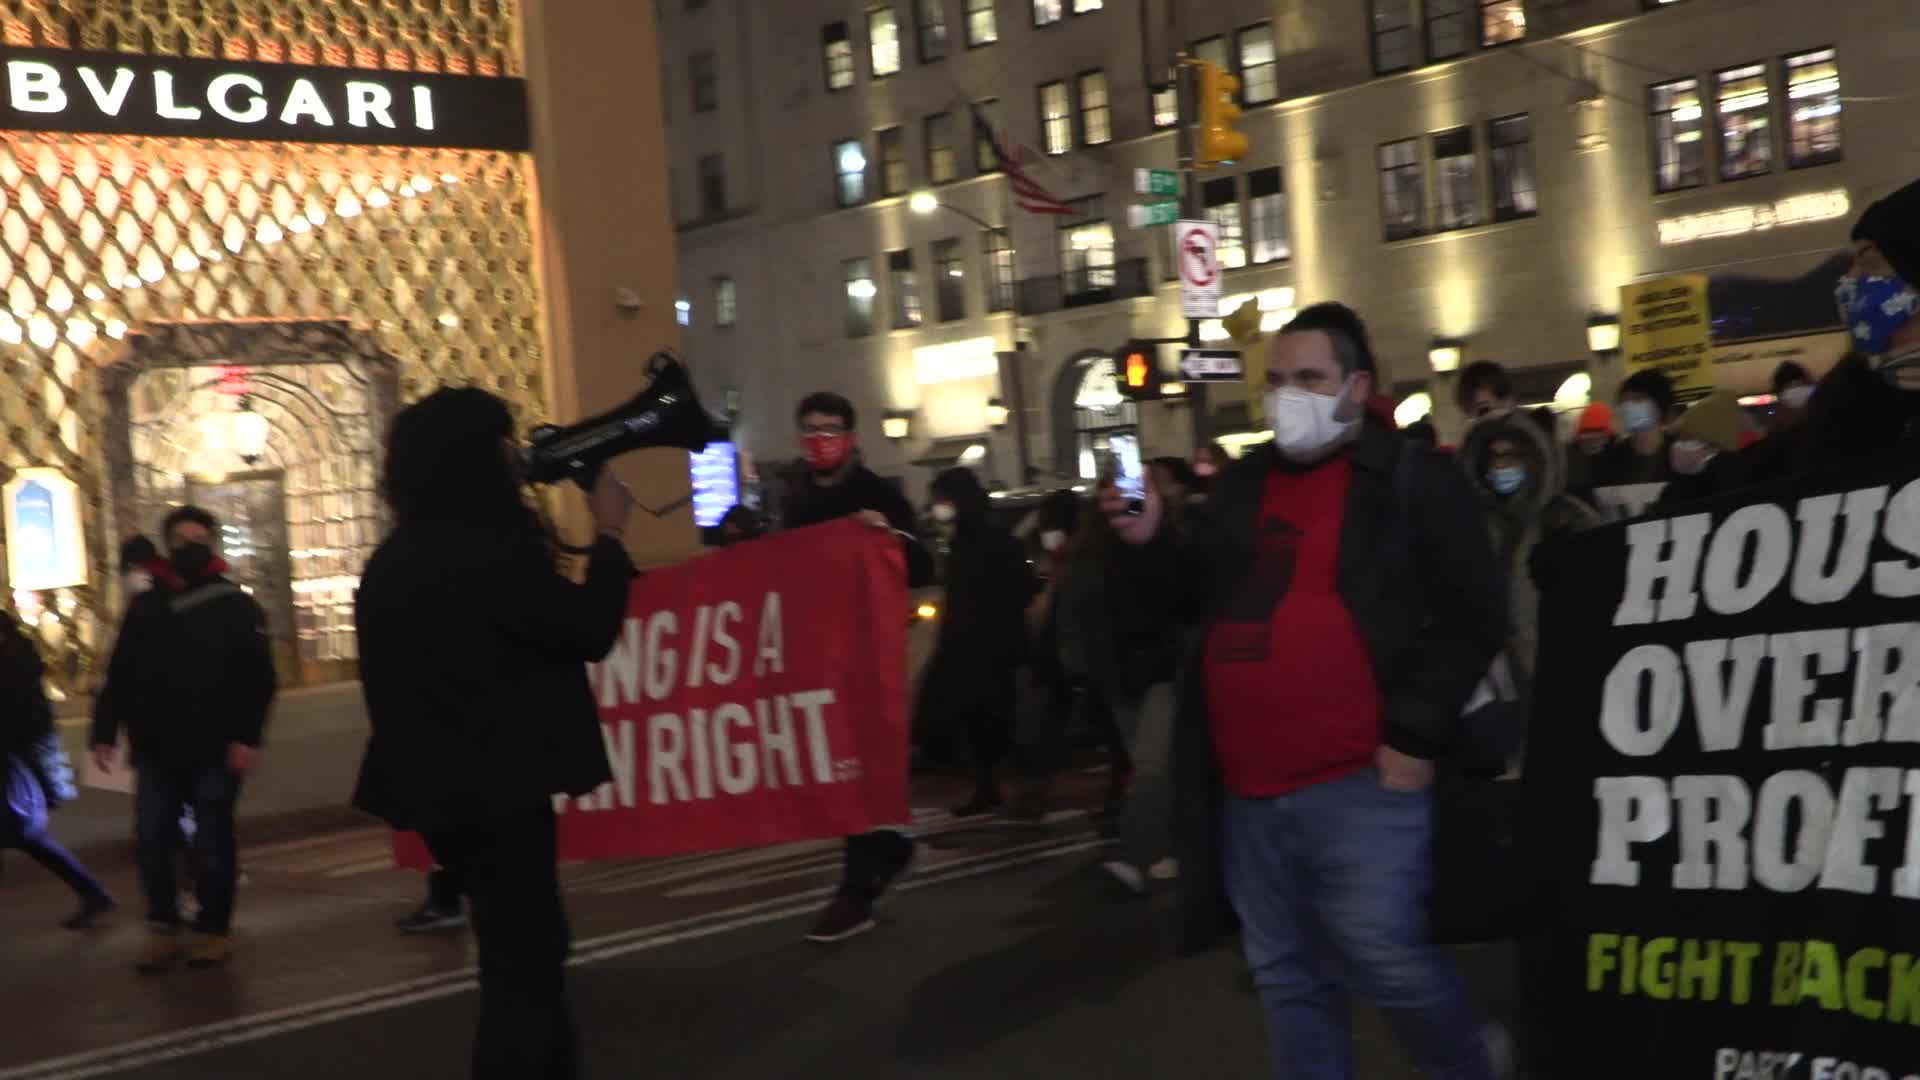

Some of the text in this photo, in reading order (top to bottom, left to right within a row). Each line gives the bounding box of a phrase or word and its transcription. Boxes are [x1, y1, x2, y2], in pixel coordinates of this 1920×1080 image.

[8, 60, 435, 131] BVLGARI
[688, 601, 742, 687] IS
[754, 592, 785, 678] A
[1599, 621, 1920, 756] OVER
[648, 689, 836, 805] RIGHT
[1586, 933, 1920, 1026] FIGHT BACK
